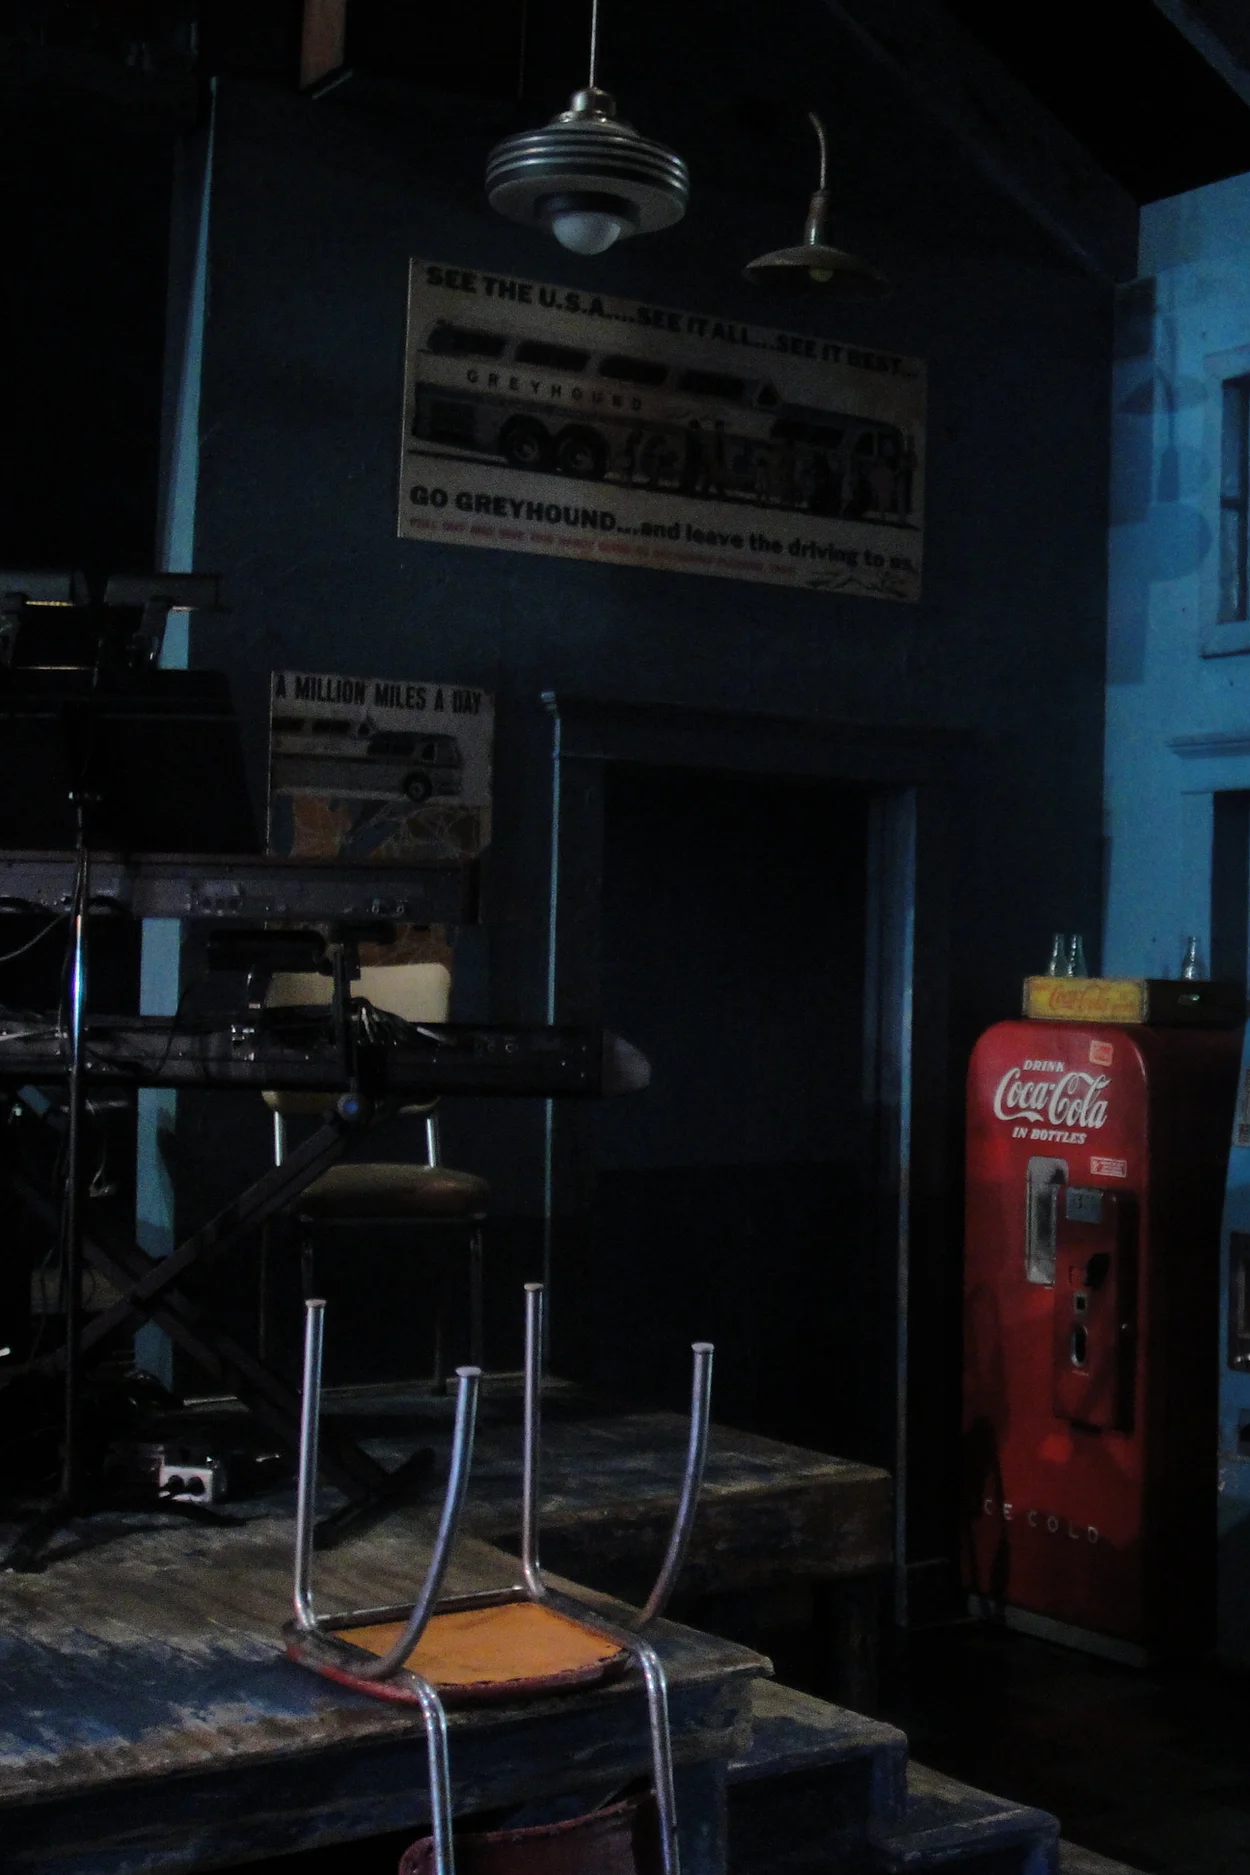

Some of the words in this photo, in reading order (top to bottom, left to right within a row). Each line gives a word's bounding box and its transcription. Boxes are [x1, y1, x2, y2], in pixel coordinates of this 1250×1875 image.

[427, 266, 476, 293] SEE
[482, 276, 532, 304] THE
[688, 315, 708, 337] IT
[467, 369, 642, 412] GREYHOUND
[410, 485, 448, 508] GO
[686, 522, 744, 549] leave
[750, 532, 783, 555] the
[788, 538, 858, 569] driving
[864, 548, 887, 568] to
[275, 674, 287, 699] A
[294, 675, 366, 706] MILLION
[375, 682, 426, 711] MILES
[434, 687, 444, 712] A
[453, 690, 482, 715] DAY
[1023, 1059, 1066, 1073] DRINK
[993, 1067, 1112, 1130] Coca-Cola
[1012, 1127, 1028, 1139] IN
[1030, 1128, 1087, 1145] BOTTLES
[1027, 1509, 1099, 1545] COLD
